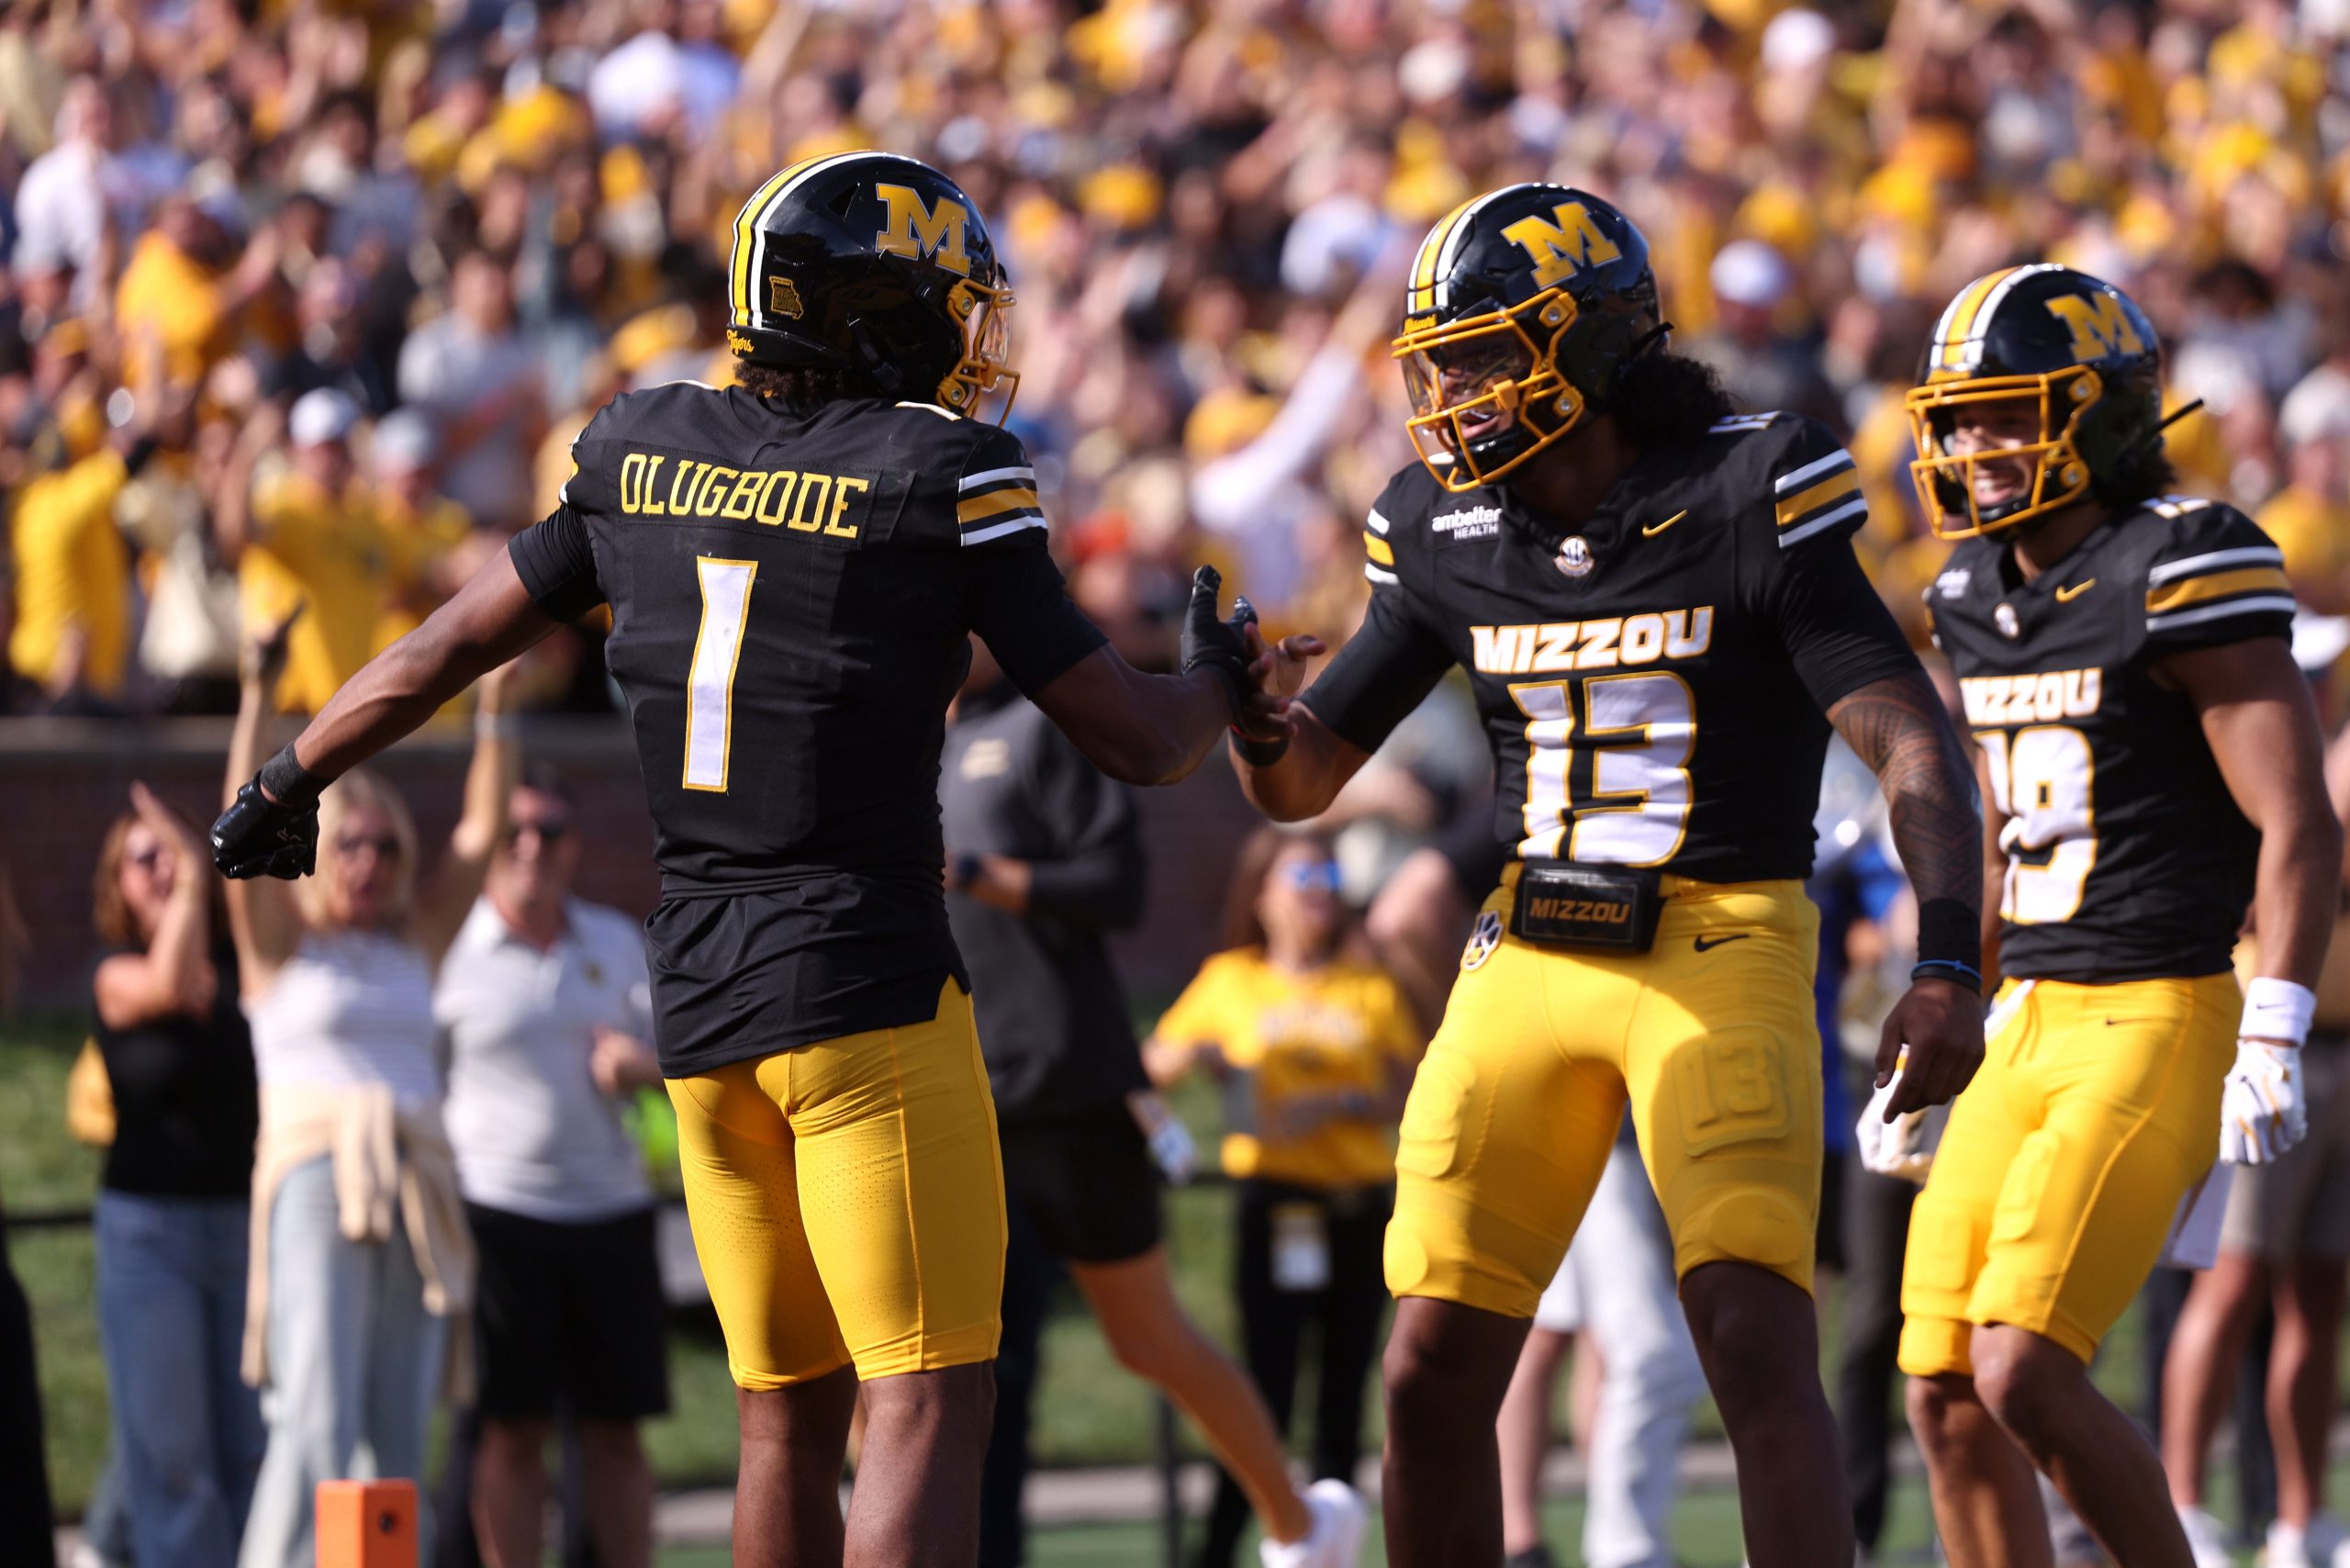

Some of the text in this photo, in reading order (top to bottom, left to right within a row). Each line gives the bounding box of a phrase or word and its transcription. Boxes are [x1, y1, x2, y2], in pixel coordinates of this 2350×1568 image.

[875, 183, 970, 275] M
[1500, 201, 1622, 290] M
[2044, 291, 2143, 362] M
[621, 453, 868, 539] OLUGBODE
[1432, 505, 1503, 532] ambetter
[1453, 522, 1499, 541] HEALTH
[682, 555, 759, 792] 1
[1470, 605, 1715, 675] MIZZOU
[1507, 669, 1697, 868] 13
[1528, 897, 1631, 924] MIZZOU
